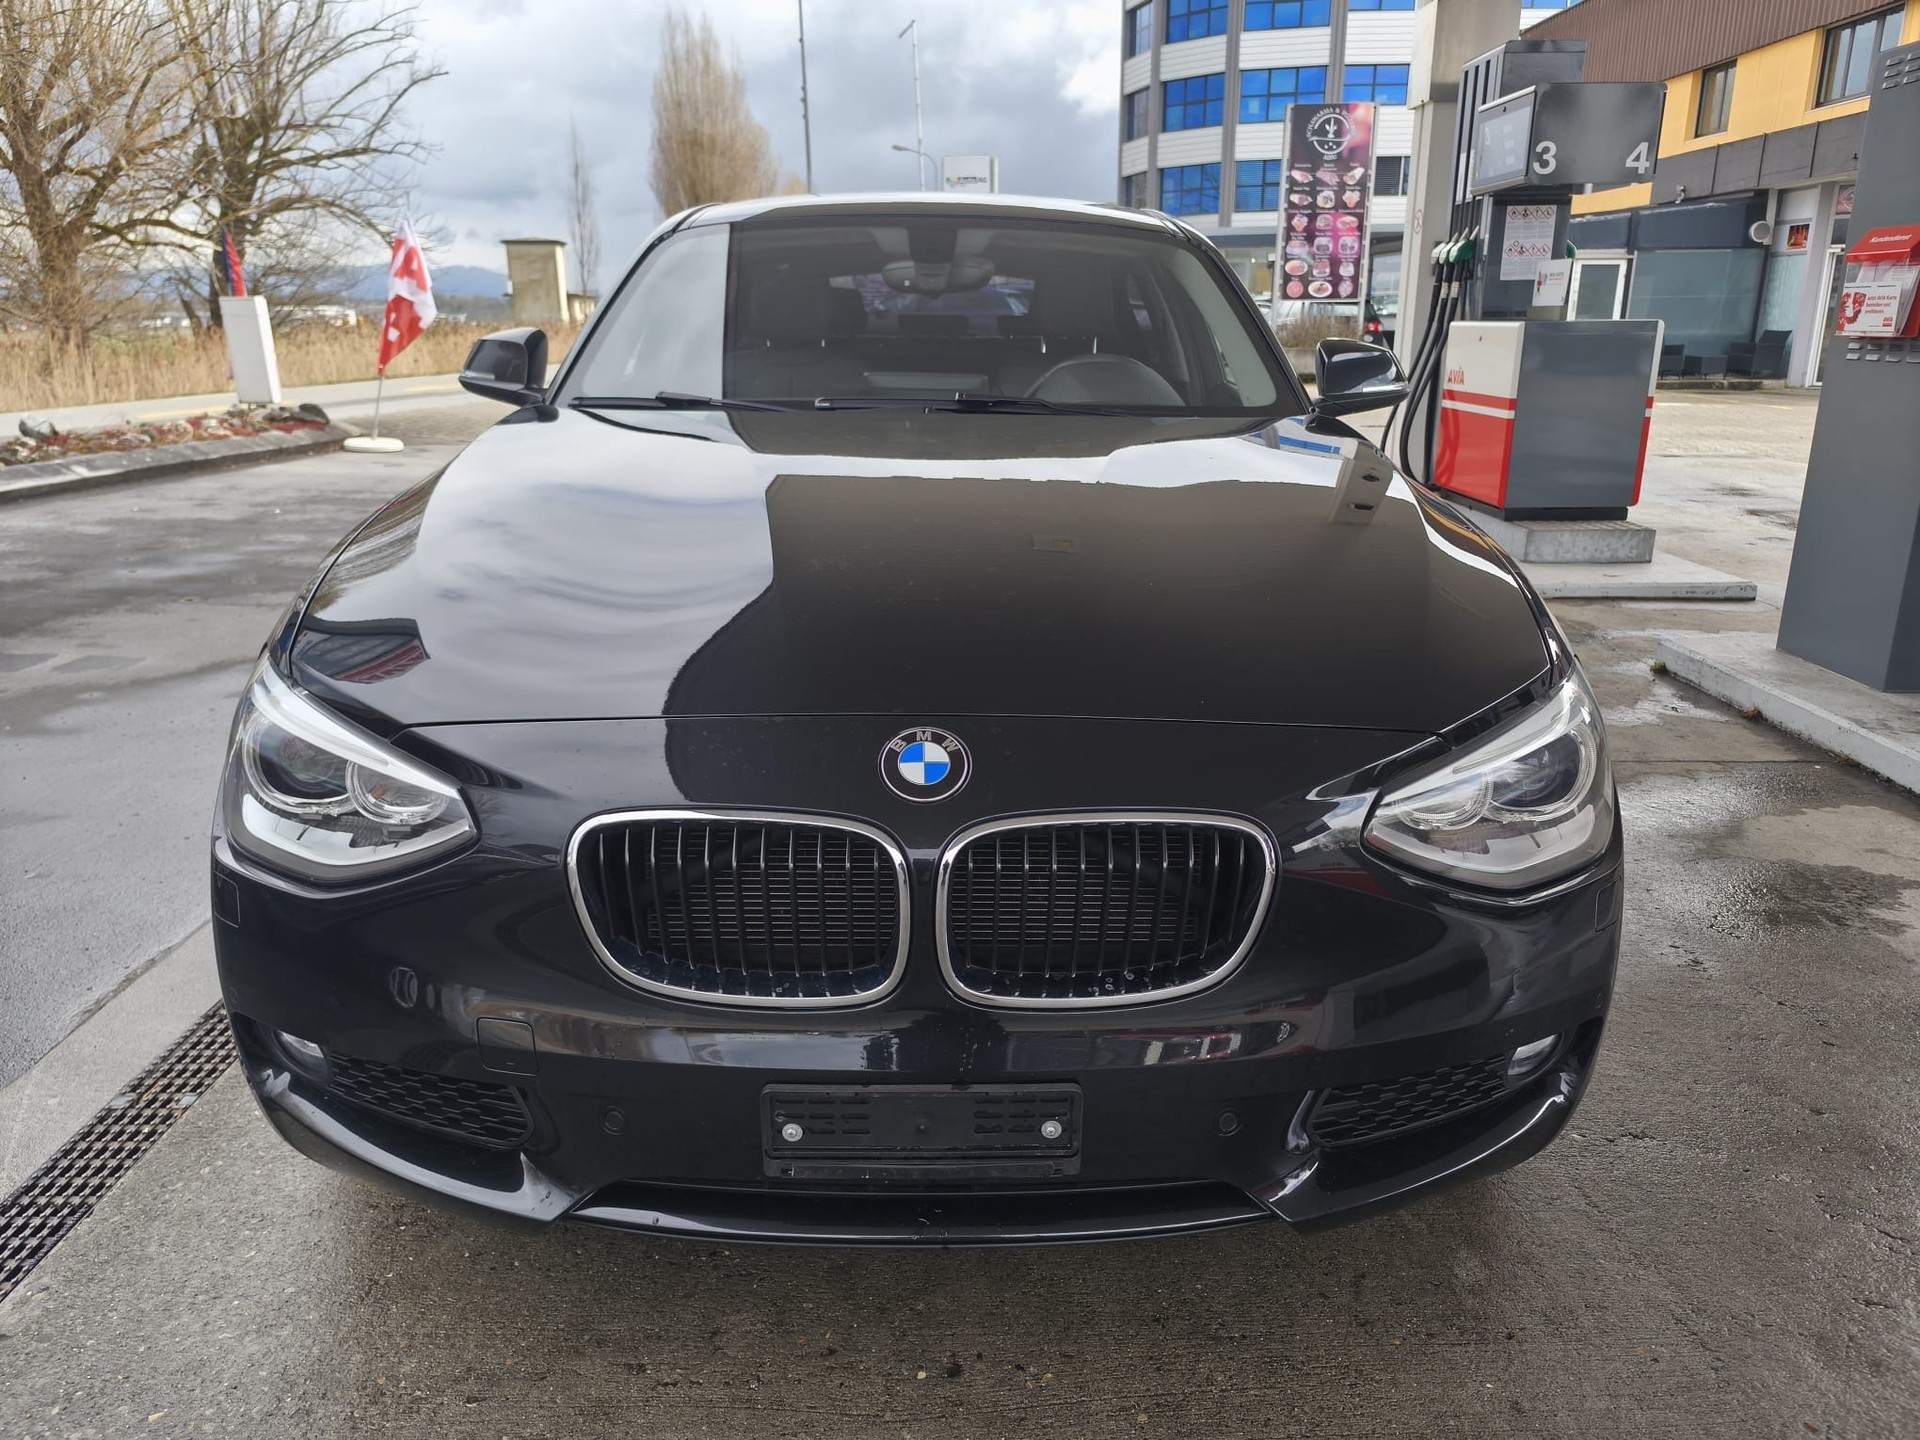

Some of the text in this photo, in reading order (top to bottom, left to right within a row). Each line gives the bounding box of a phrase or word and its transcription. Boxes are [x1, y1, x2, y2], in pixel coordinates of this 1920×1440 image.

[1532, 140, 1557, 175] 3
[1625, 141, 1650, 174] 4
[890, 730, 960, 753] BMW
